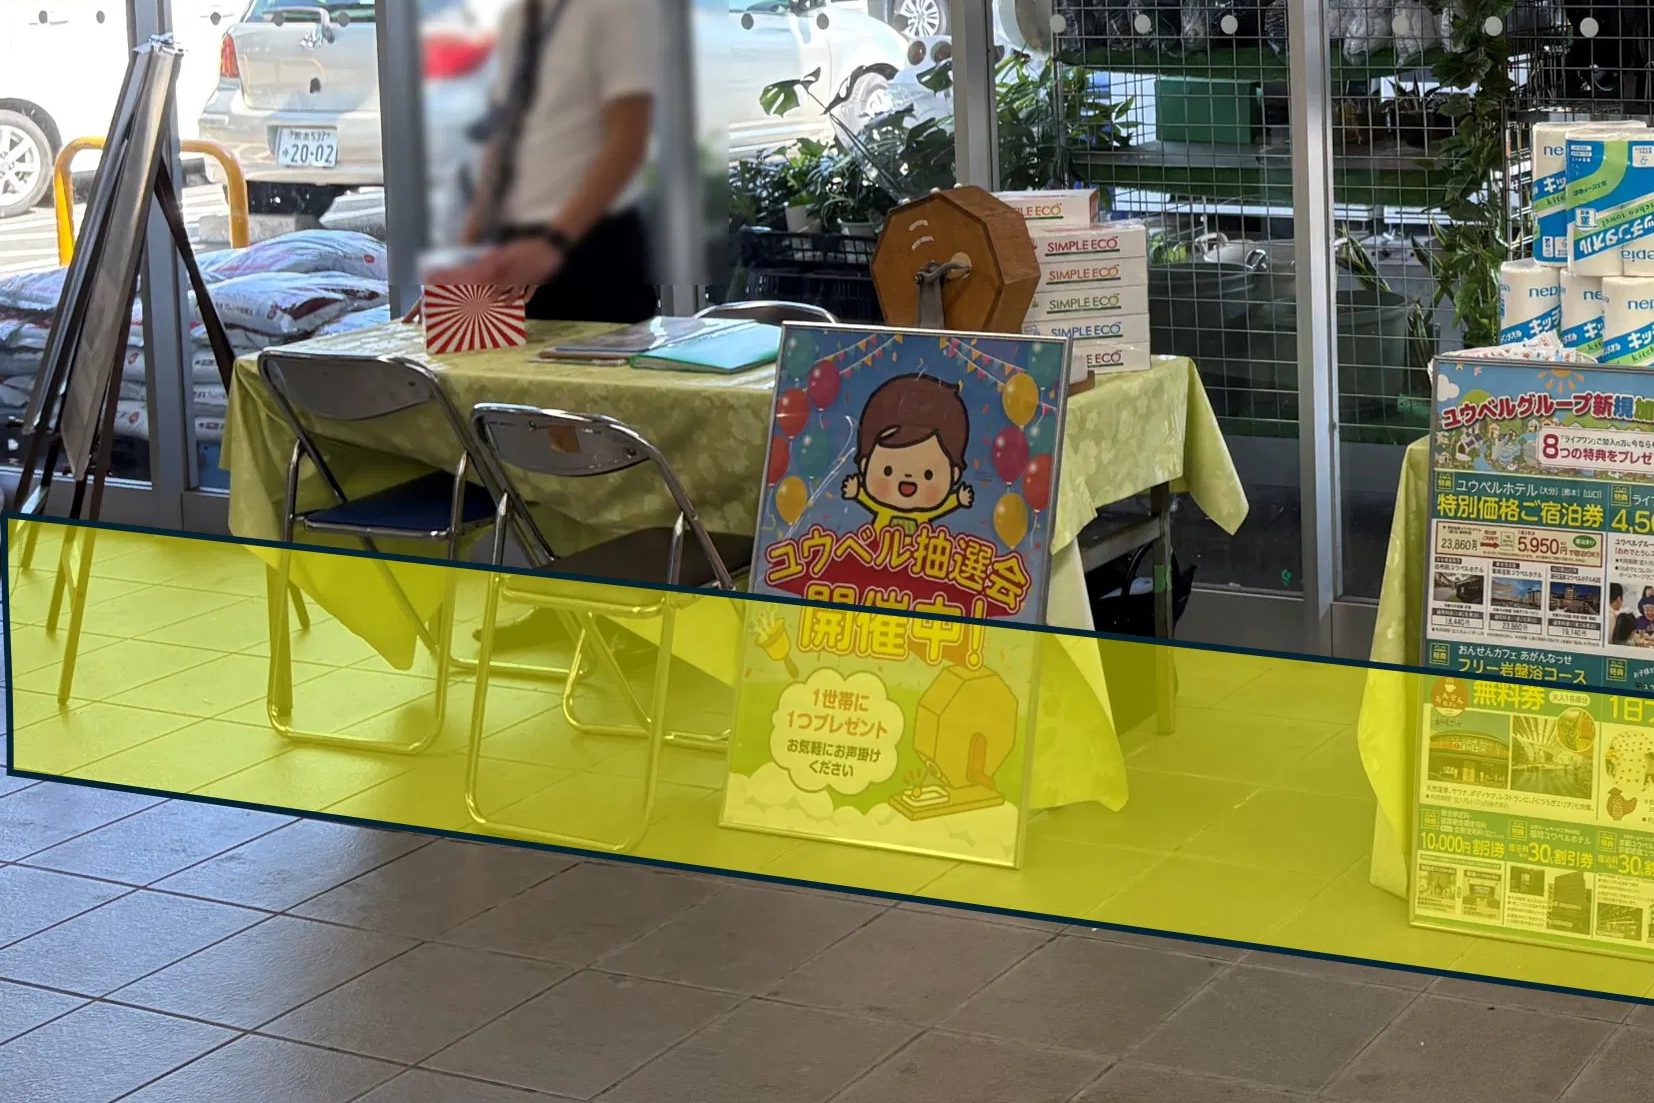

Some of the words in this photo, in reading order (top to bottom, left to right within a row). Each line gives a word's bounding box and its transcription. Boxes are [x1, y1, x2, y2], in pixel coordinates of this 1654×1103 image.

[1035, 202, 1062, 217] ECO
[1047, 239, 1089, 253] SIMPLE
[1091, 236, 1118, 250] ECO
[1049, 268, 1090, 282] SIMPLE
[1091, 264, 1120, 278] ECO
[1050, 296, 1091, 310] SIMPLE
[1092, 293, 1120, 308] ECO
[1051, 326, 1092, 338] SIMPLE
[1093, 323, 1121, 336] ECO
[1094, 351, 1122, 364] ECO
[1456, 480, 1538, 497] ユウベルホテル
[1437, 494, 1604, 528] 特別価格ご宿泊券
[767, 526, 1029, 612] ユウベル抽選会
[799, 587, 985, 668] 開催中!
[1459, 645, 1520, 659] おんせんカフェ
[1520, 650, 1572, 665] あがんなっせ
[1458, 658, 1587, 685] フリー岩盤浴コース
[812, 688, 868, 713] 1世帯に
[1473, 680, 1545, 711] 無料券
[787, 711, 888, 739] 1つプレゼント
[787, 738, 880, 762] お気軽にお声掛け
[809, 760, 854, 777] ください
